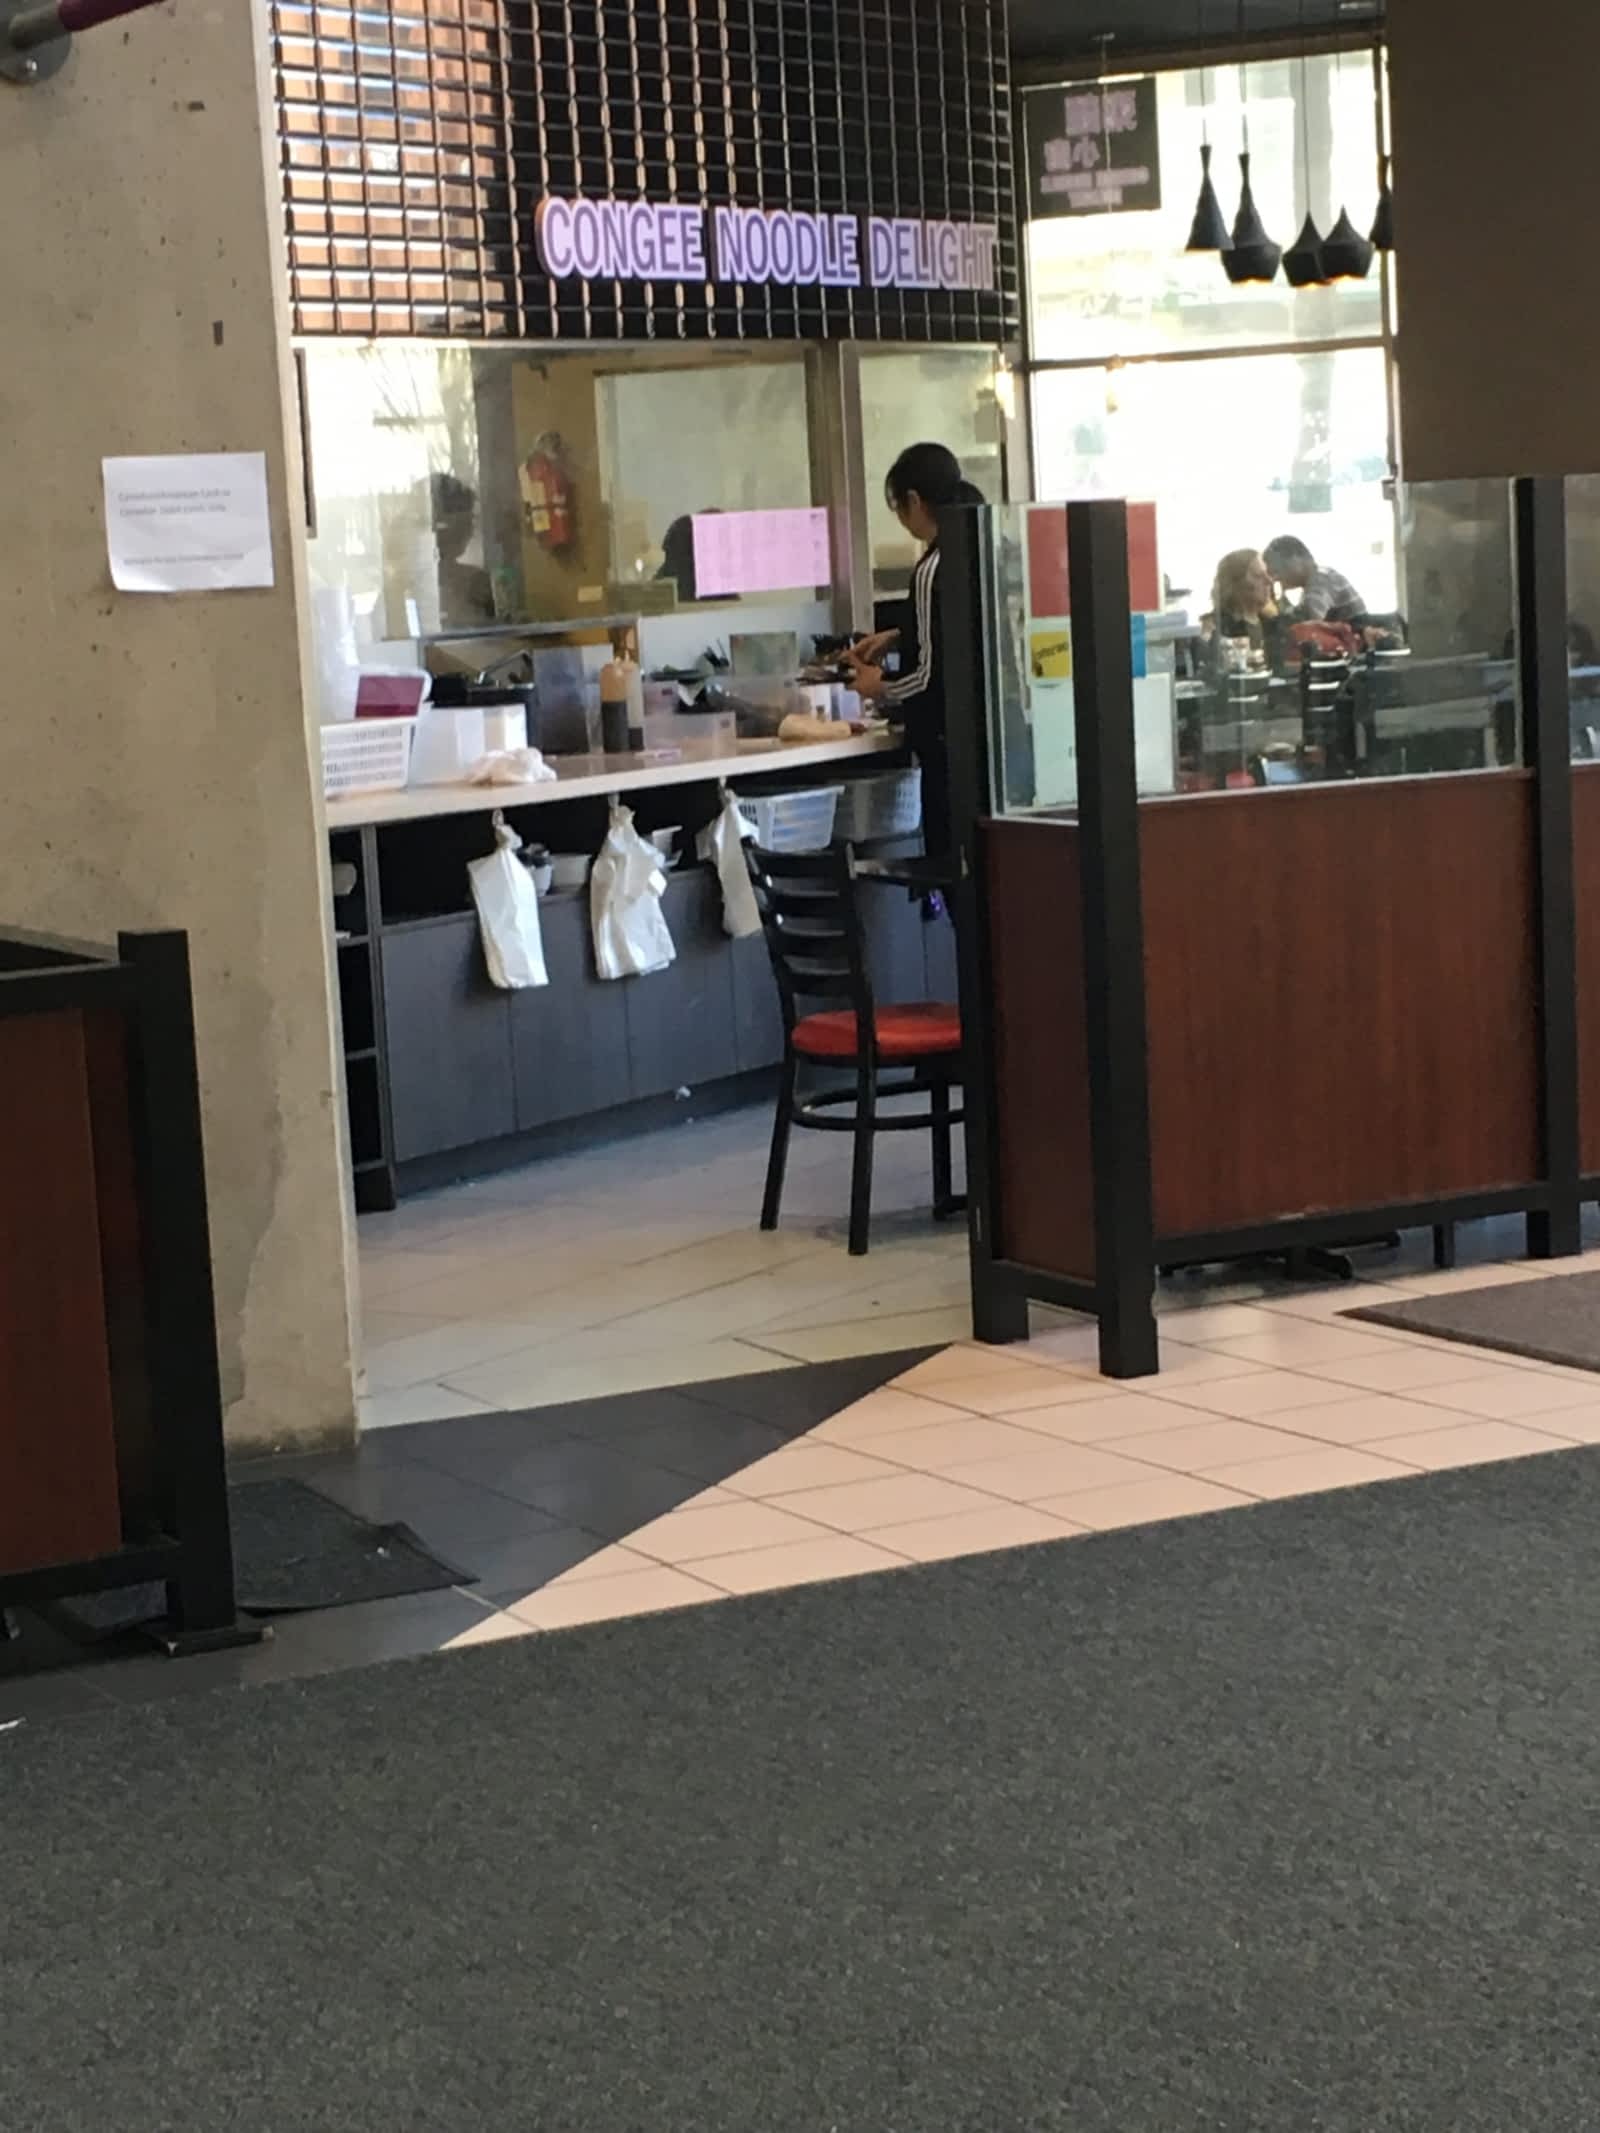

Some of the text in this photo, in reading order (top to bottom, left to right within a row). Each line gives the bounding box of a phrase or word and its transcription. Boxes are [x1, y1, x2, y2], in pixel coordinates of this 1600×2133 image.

[541, 198, 998, 290] CONGEE NOODLE DELIGHT
